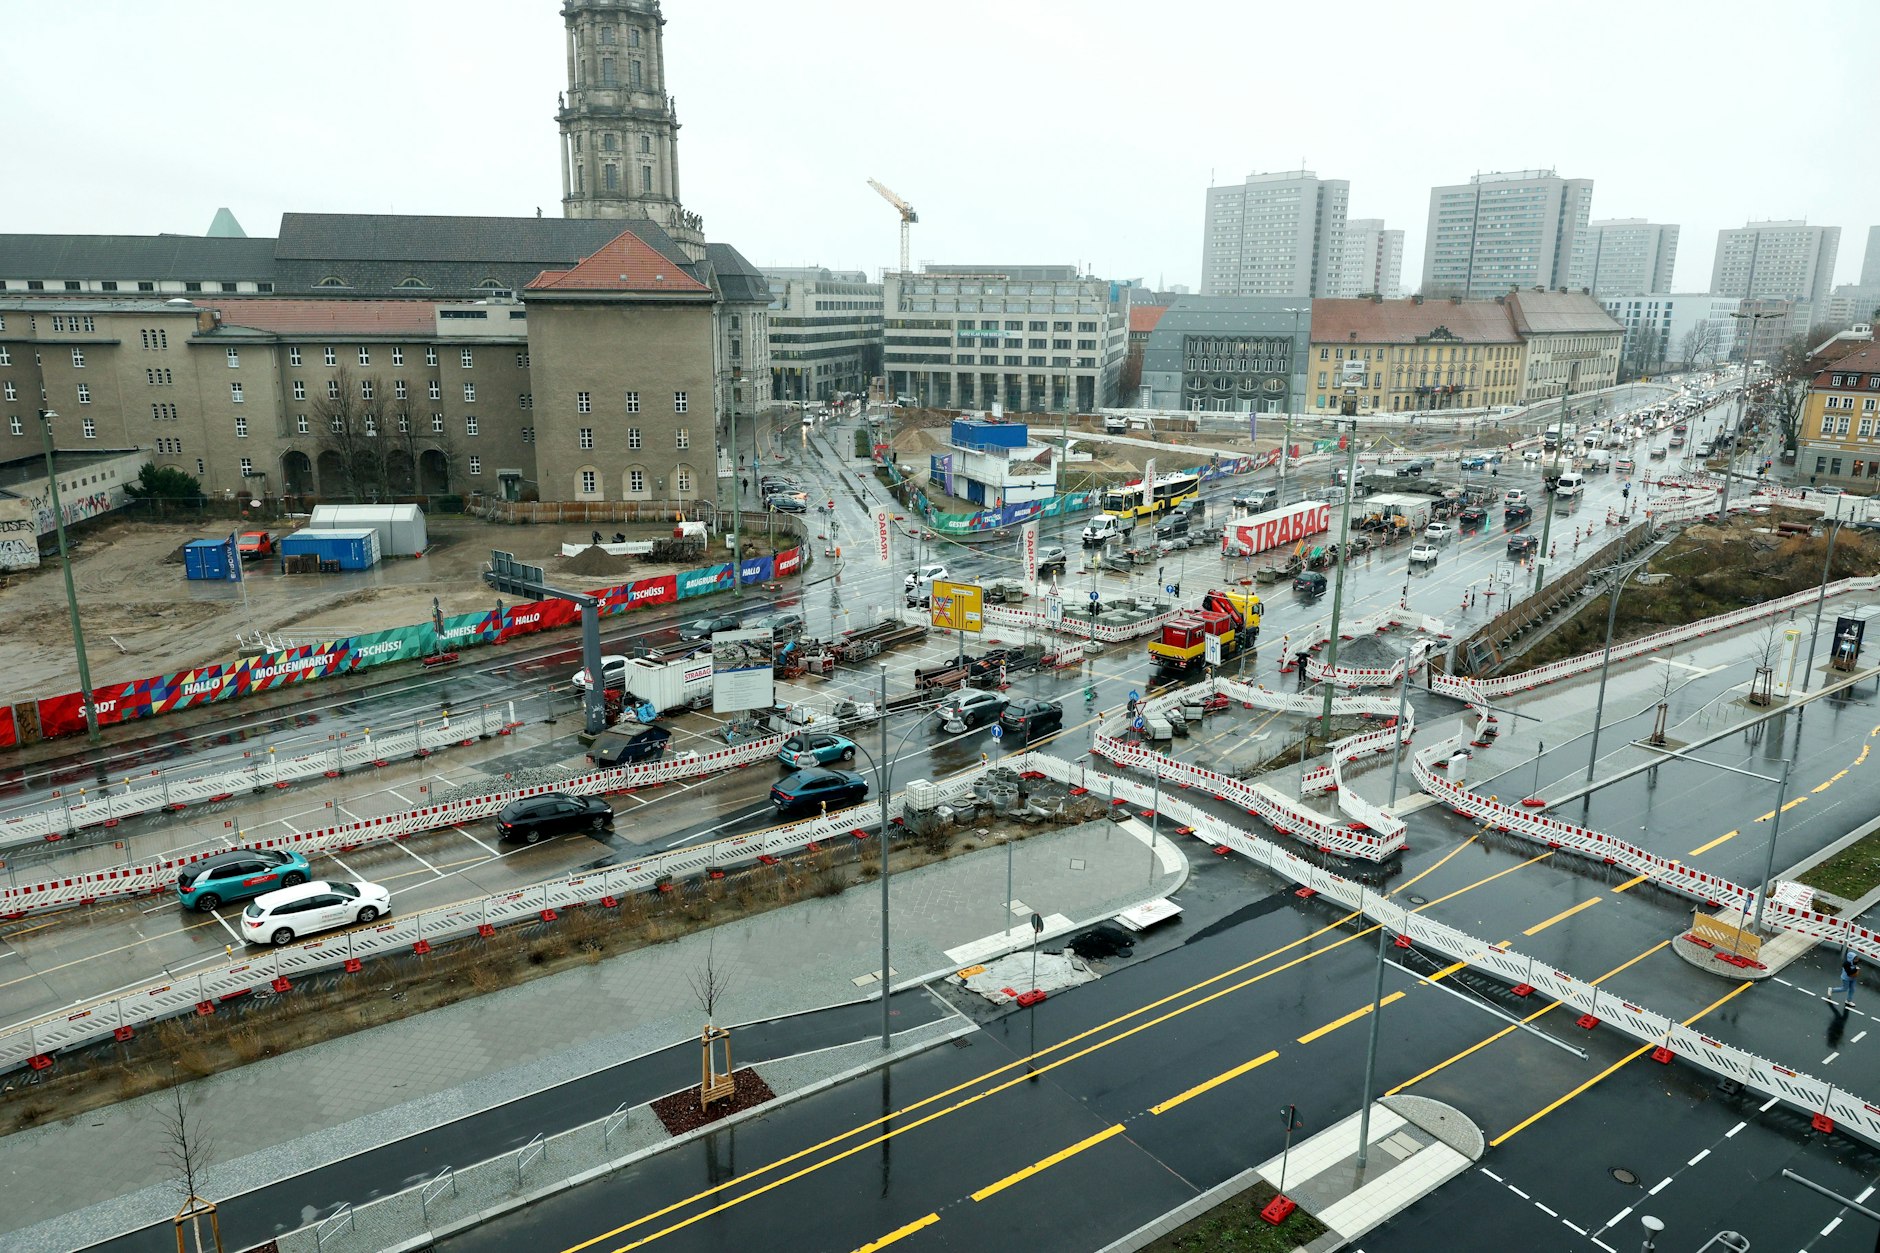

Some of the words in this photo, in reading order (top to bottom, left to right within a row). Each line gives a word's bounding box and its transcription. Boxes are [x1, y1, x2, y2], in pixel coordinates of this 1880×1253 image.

[1236, 504, 1330, 556] STRABAG
[742, 566, 760, 577] HALLO
[632, 586, 664, 600] TSCHÜSSI
[515, 612, 540, 626] HALLO
[437, 624, 477, 640] CHNEISE
[358, 640, 402, 658] TSCHÜSSI
[255, 654, 335, 680] MOLKENMARKT
[684, 668, 711, 681] STRABAG
[184, 678, 221, 695] HALLO
[78, 699, 117, 718] SADT
